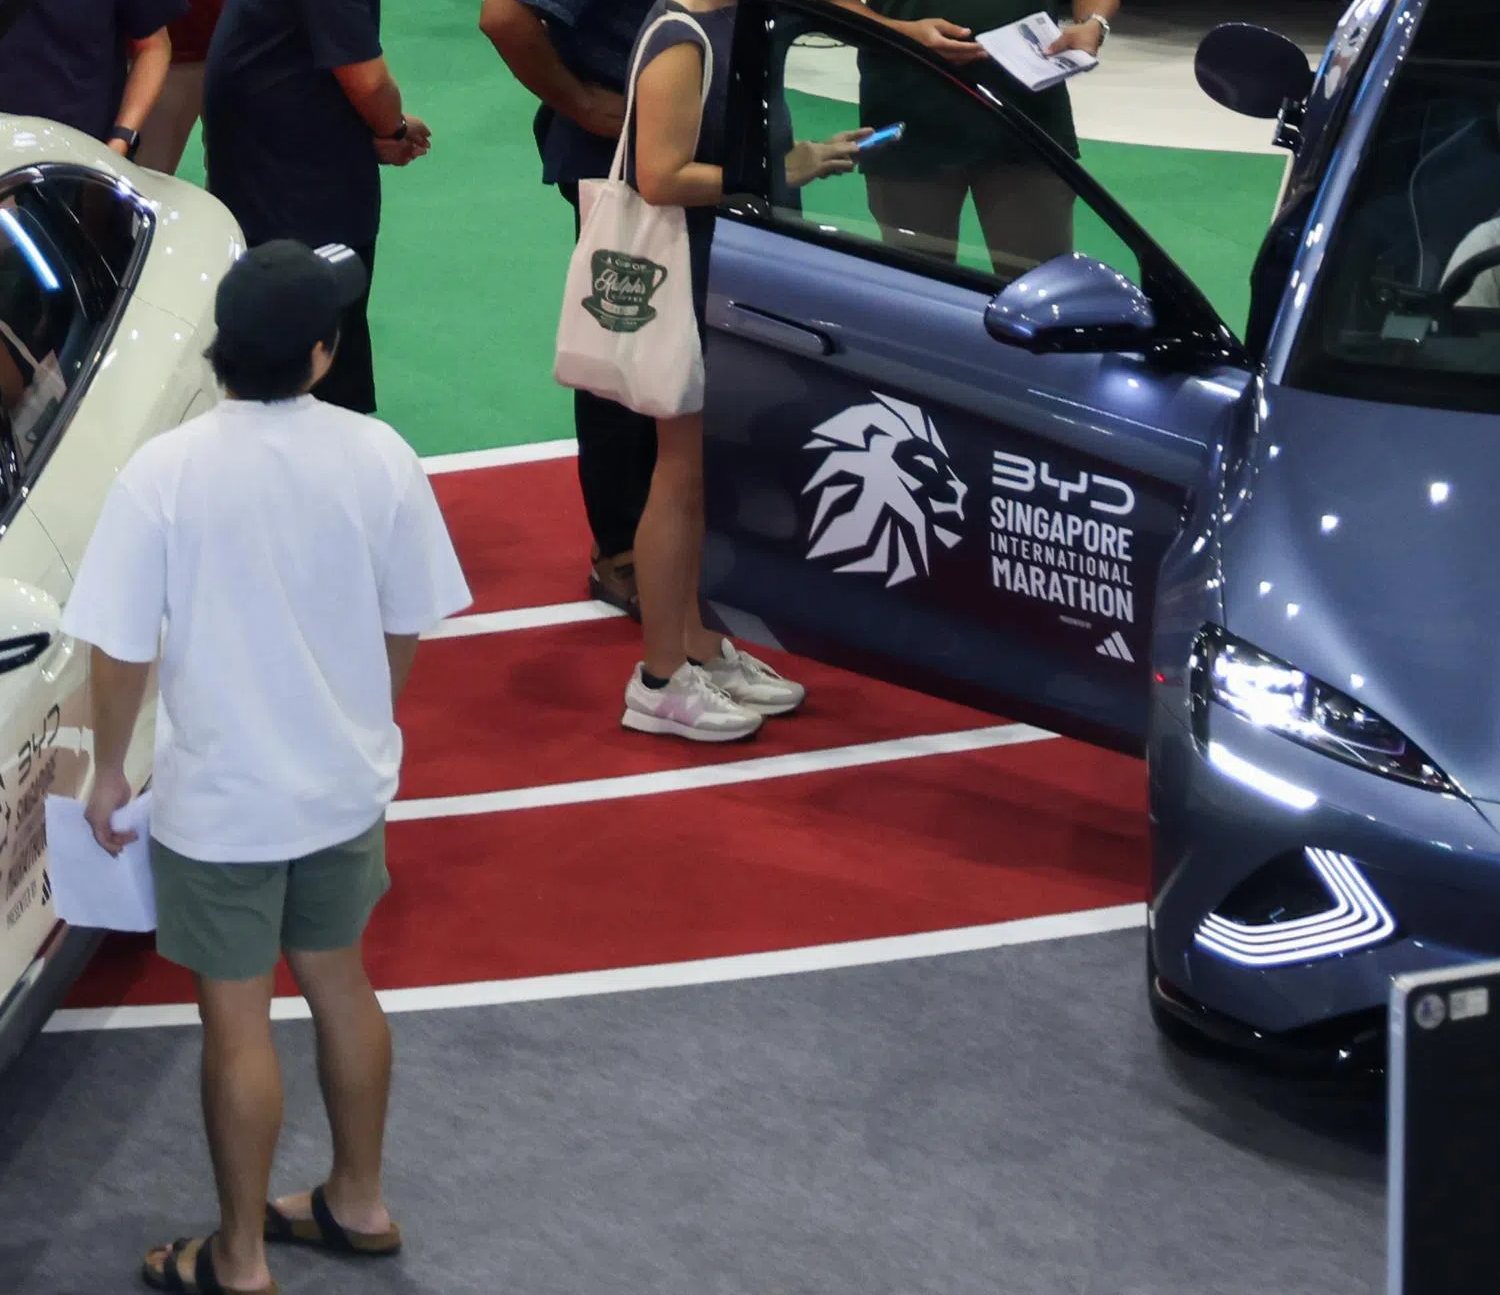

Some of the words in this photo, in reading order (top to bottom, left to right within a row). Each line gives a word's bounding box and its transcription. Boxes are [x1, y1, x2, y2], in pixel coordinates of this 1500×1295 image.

[991, 450, 1135, 515] BYD
[990, 495, 1133, 562] SINGAPORE
[990, 532, 1132, 586] INTERNATIONAL
[991, 557, 1134, 623] MARATHON
